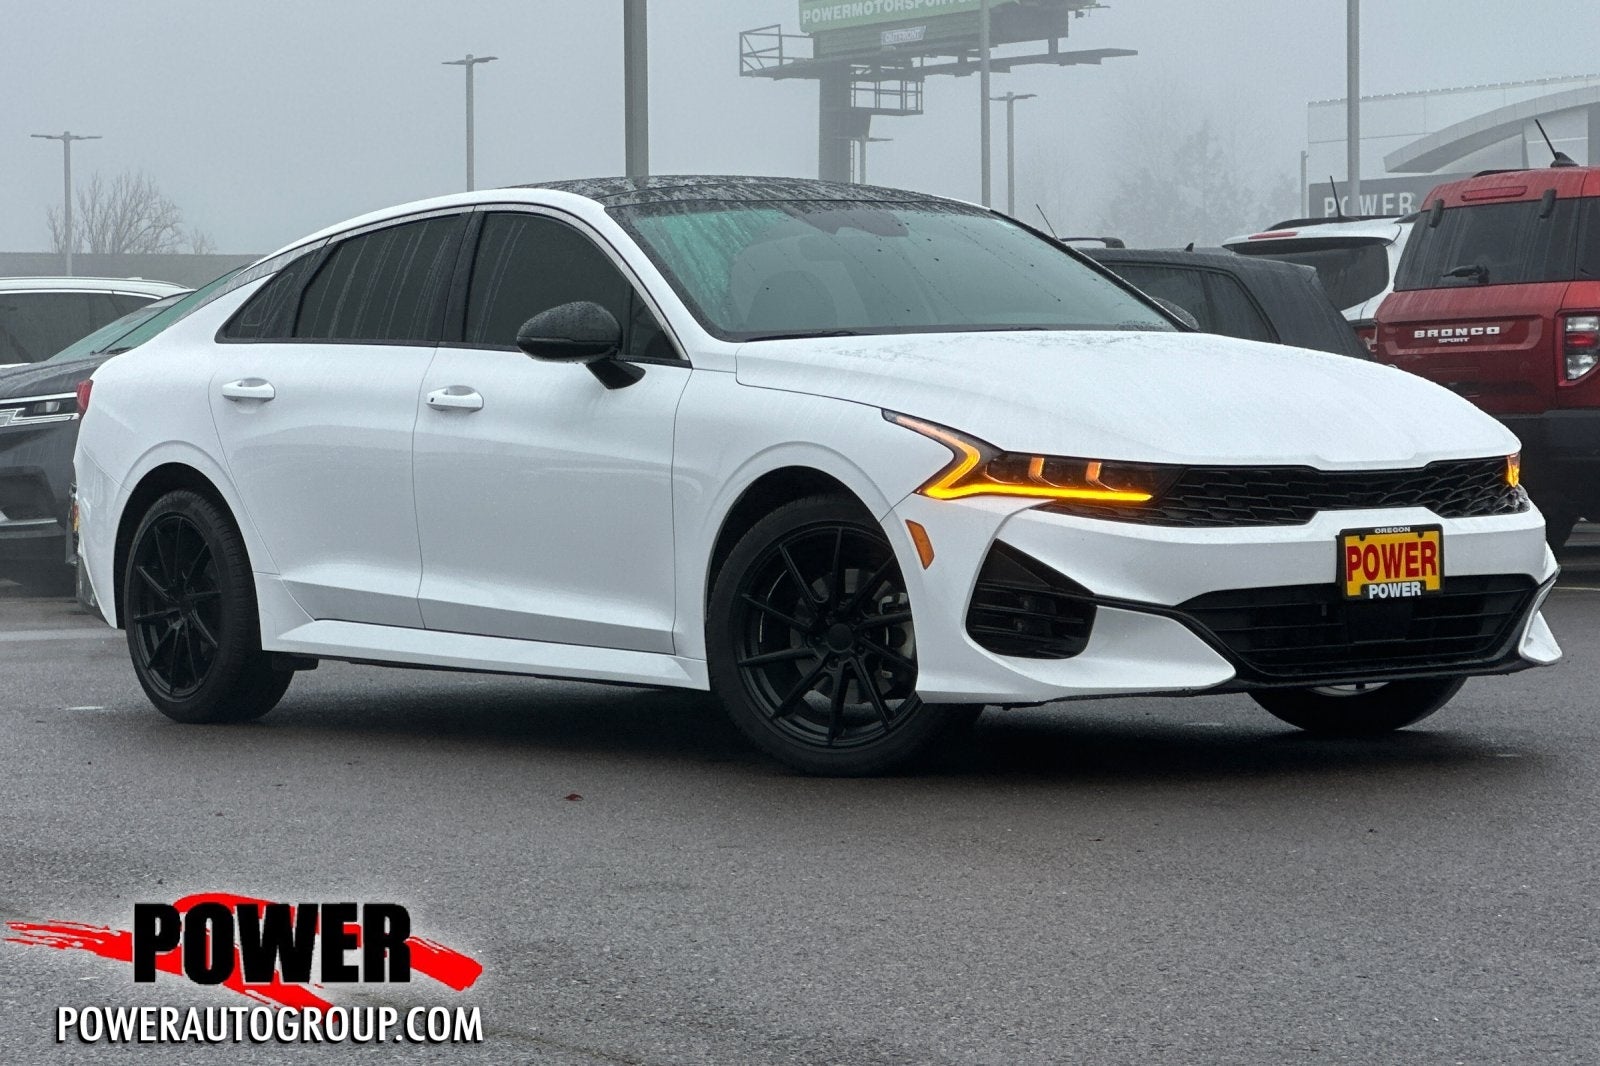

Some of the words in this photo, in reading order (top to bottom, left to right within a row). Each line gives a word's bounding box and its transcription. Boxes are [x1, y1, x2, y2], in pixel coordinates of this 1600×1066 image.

[1414, 326, 1500, 338] BRONCO
[1374, 526, 1411, 534] OREGON
[1346, 540, 1437, 582] POWER
[1368, 581, 1421, 599] POWER
